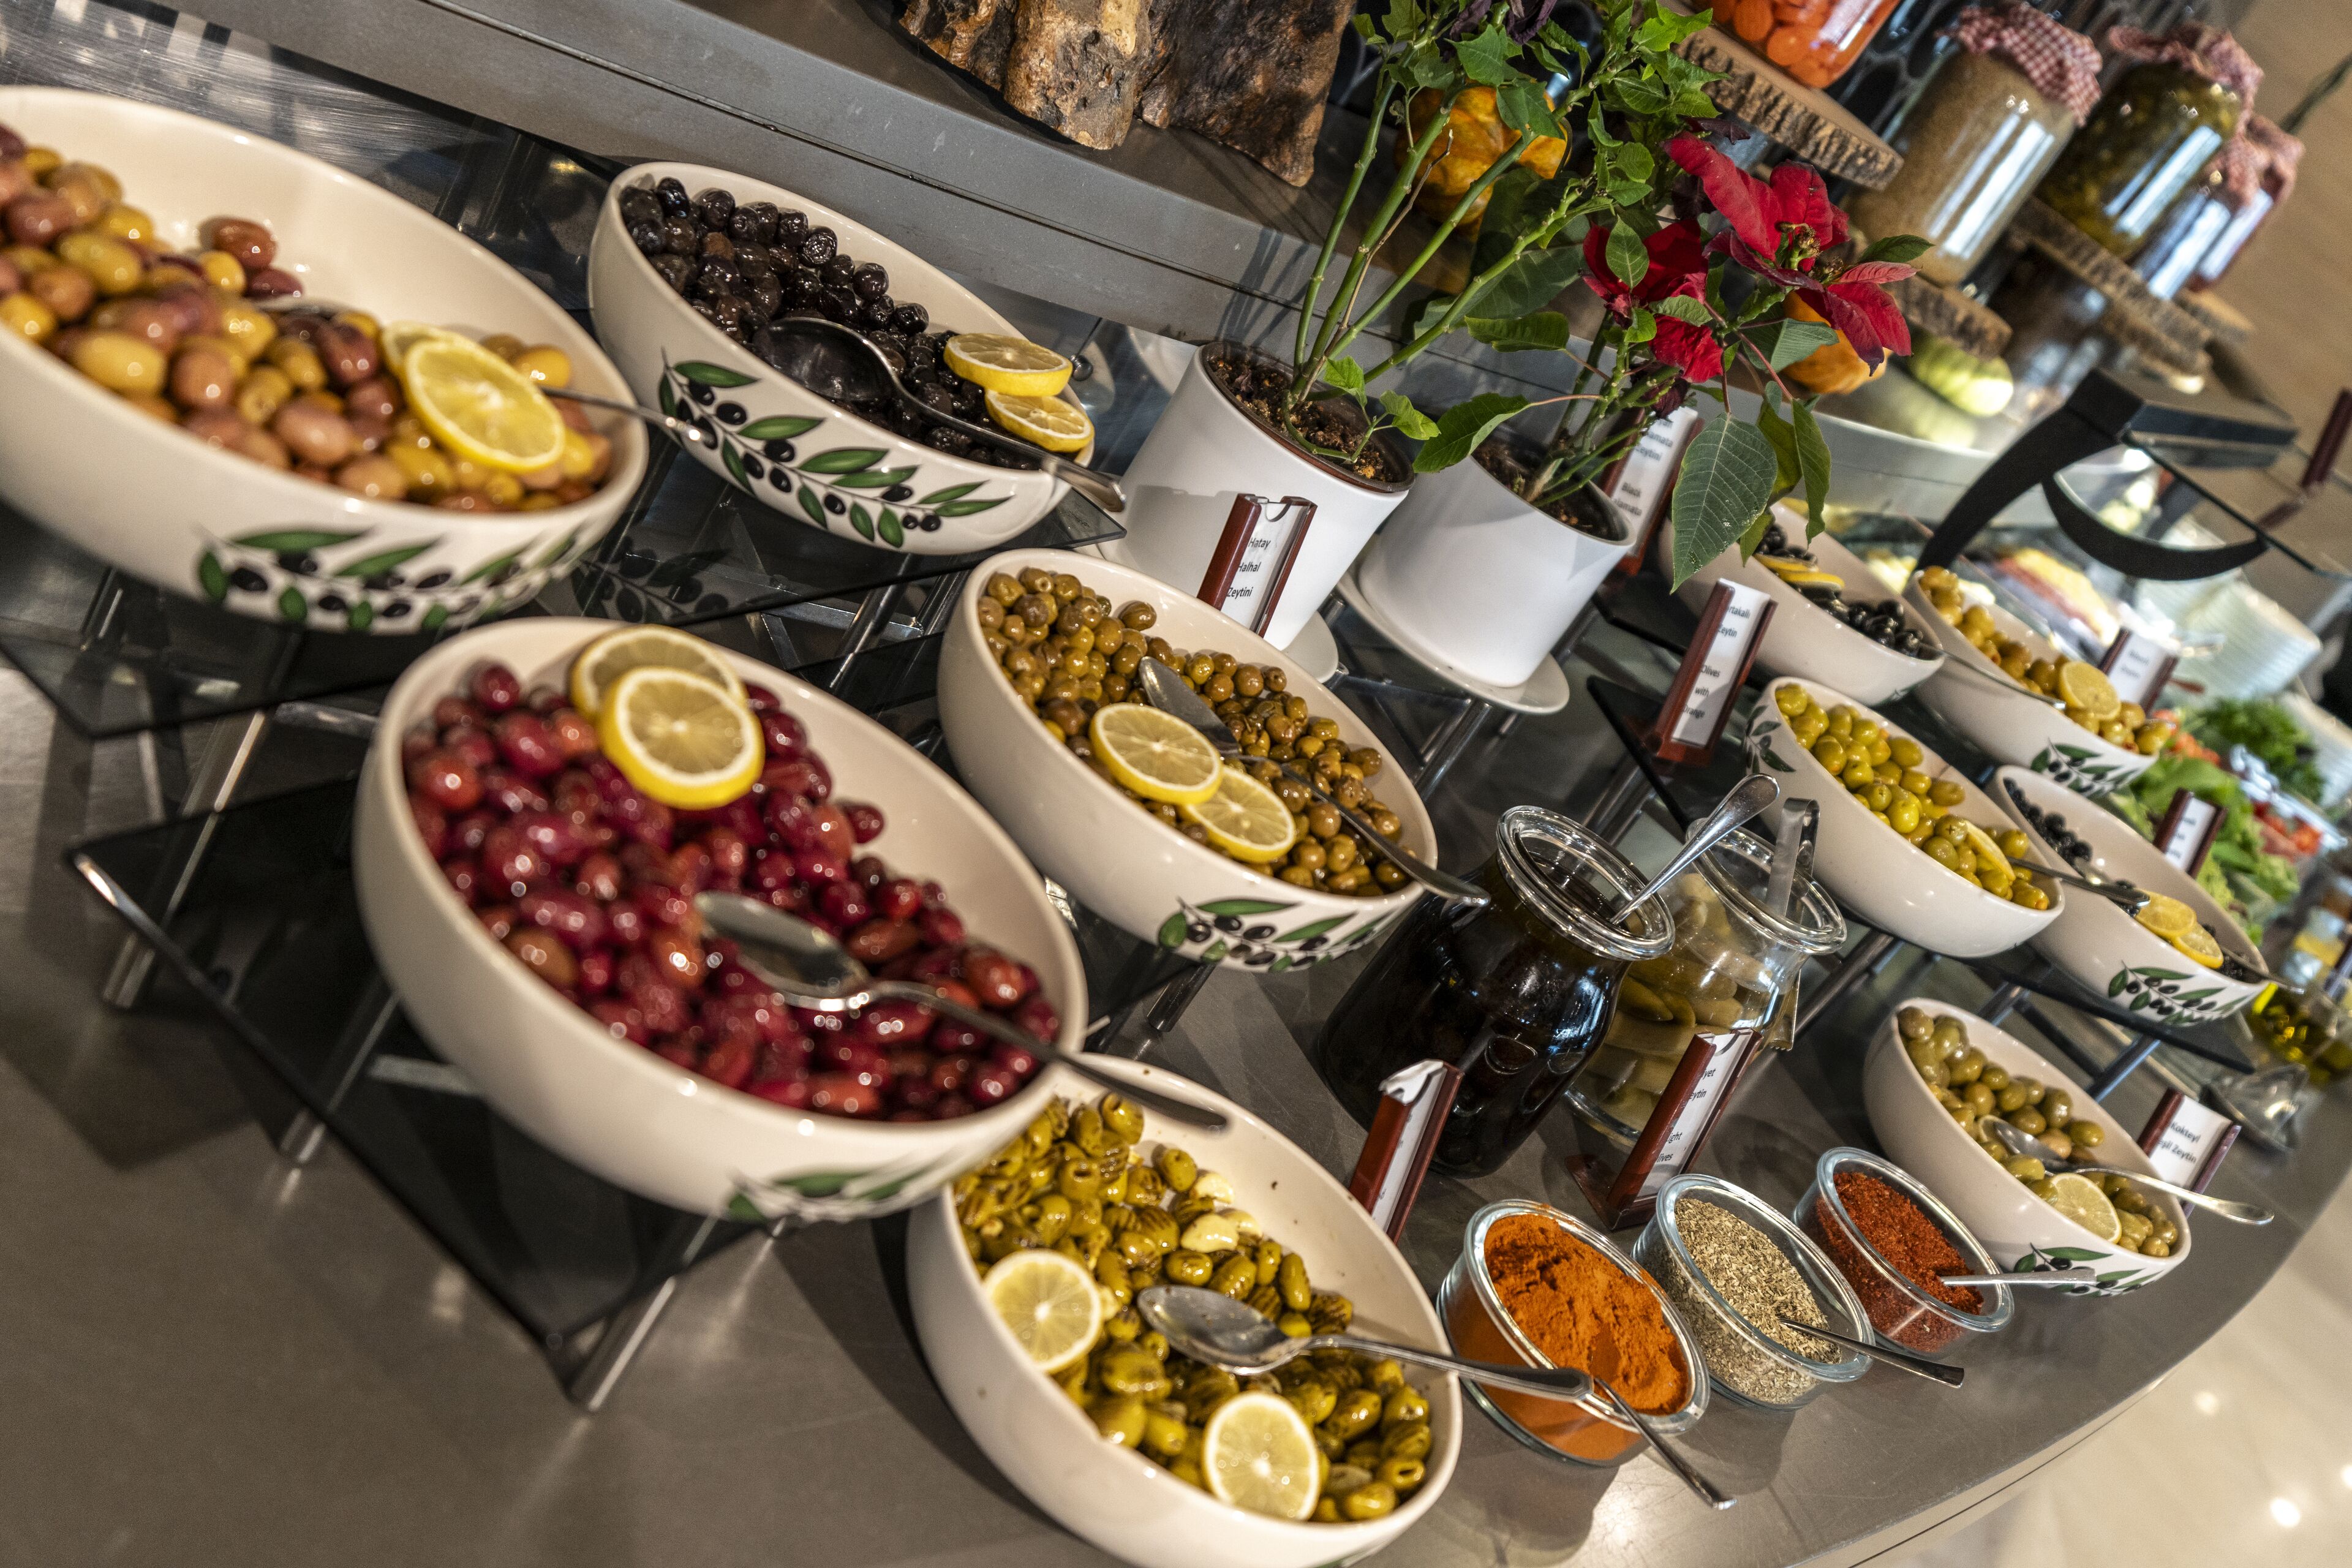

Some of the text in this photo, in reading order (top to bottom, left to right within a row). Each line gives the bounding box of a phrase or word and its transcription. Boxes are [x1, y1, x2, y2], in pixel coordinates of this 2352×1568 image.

[1248, 538, 1271, 550] Hatay
[1238, 561, 1262, 572] Halhal
[1227, 587, 1254, 600] Zeytini
[1700, 665, 1721, 678] Olives
[1694, 687, 1710, 697] with
[1683, 705, 1705, 719] Orange
[1689, 1089, 1708, 1102] eytin
[1665, 1131, 1684, 1144] ight
[2170, 1121, 2201, 1144] Kokteyl
[2159, 1139, 2198, 1164] eşil Zeytin
[1656, 1153, 1674, 1164] lives
